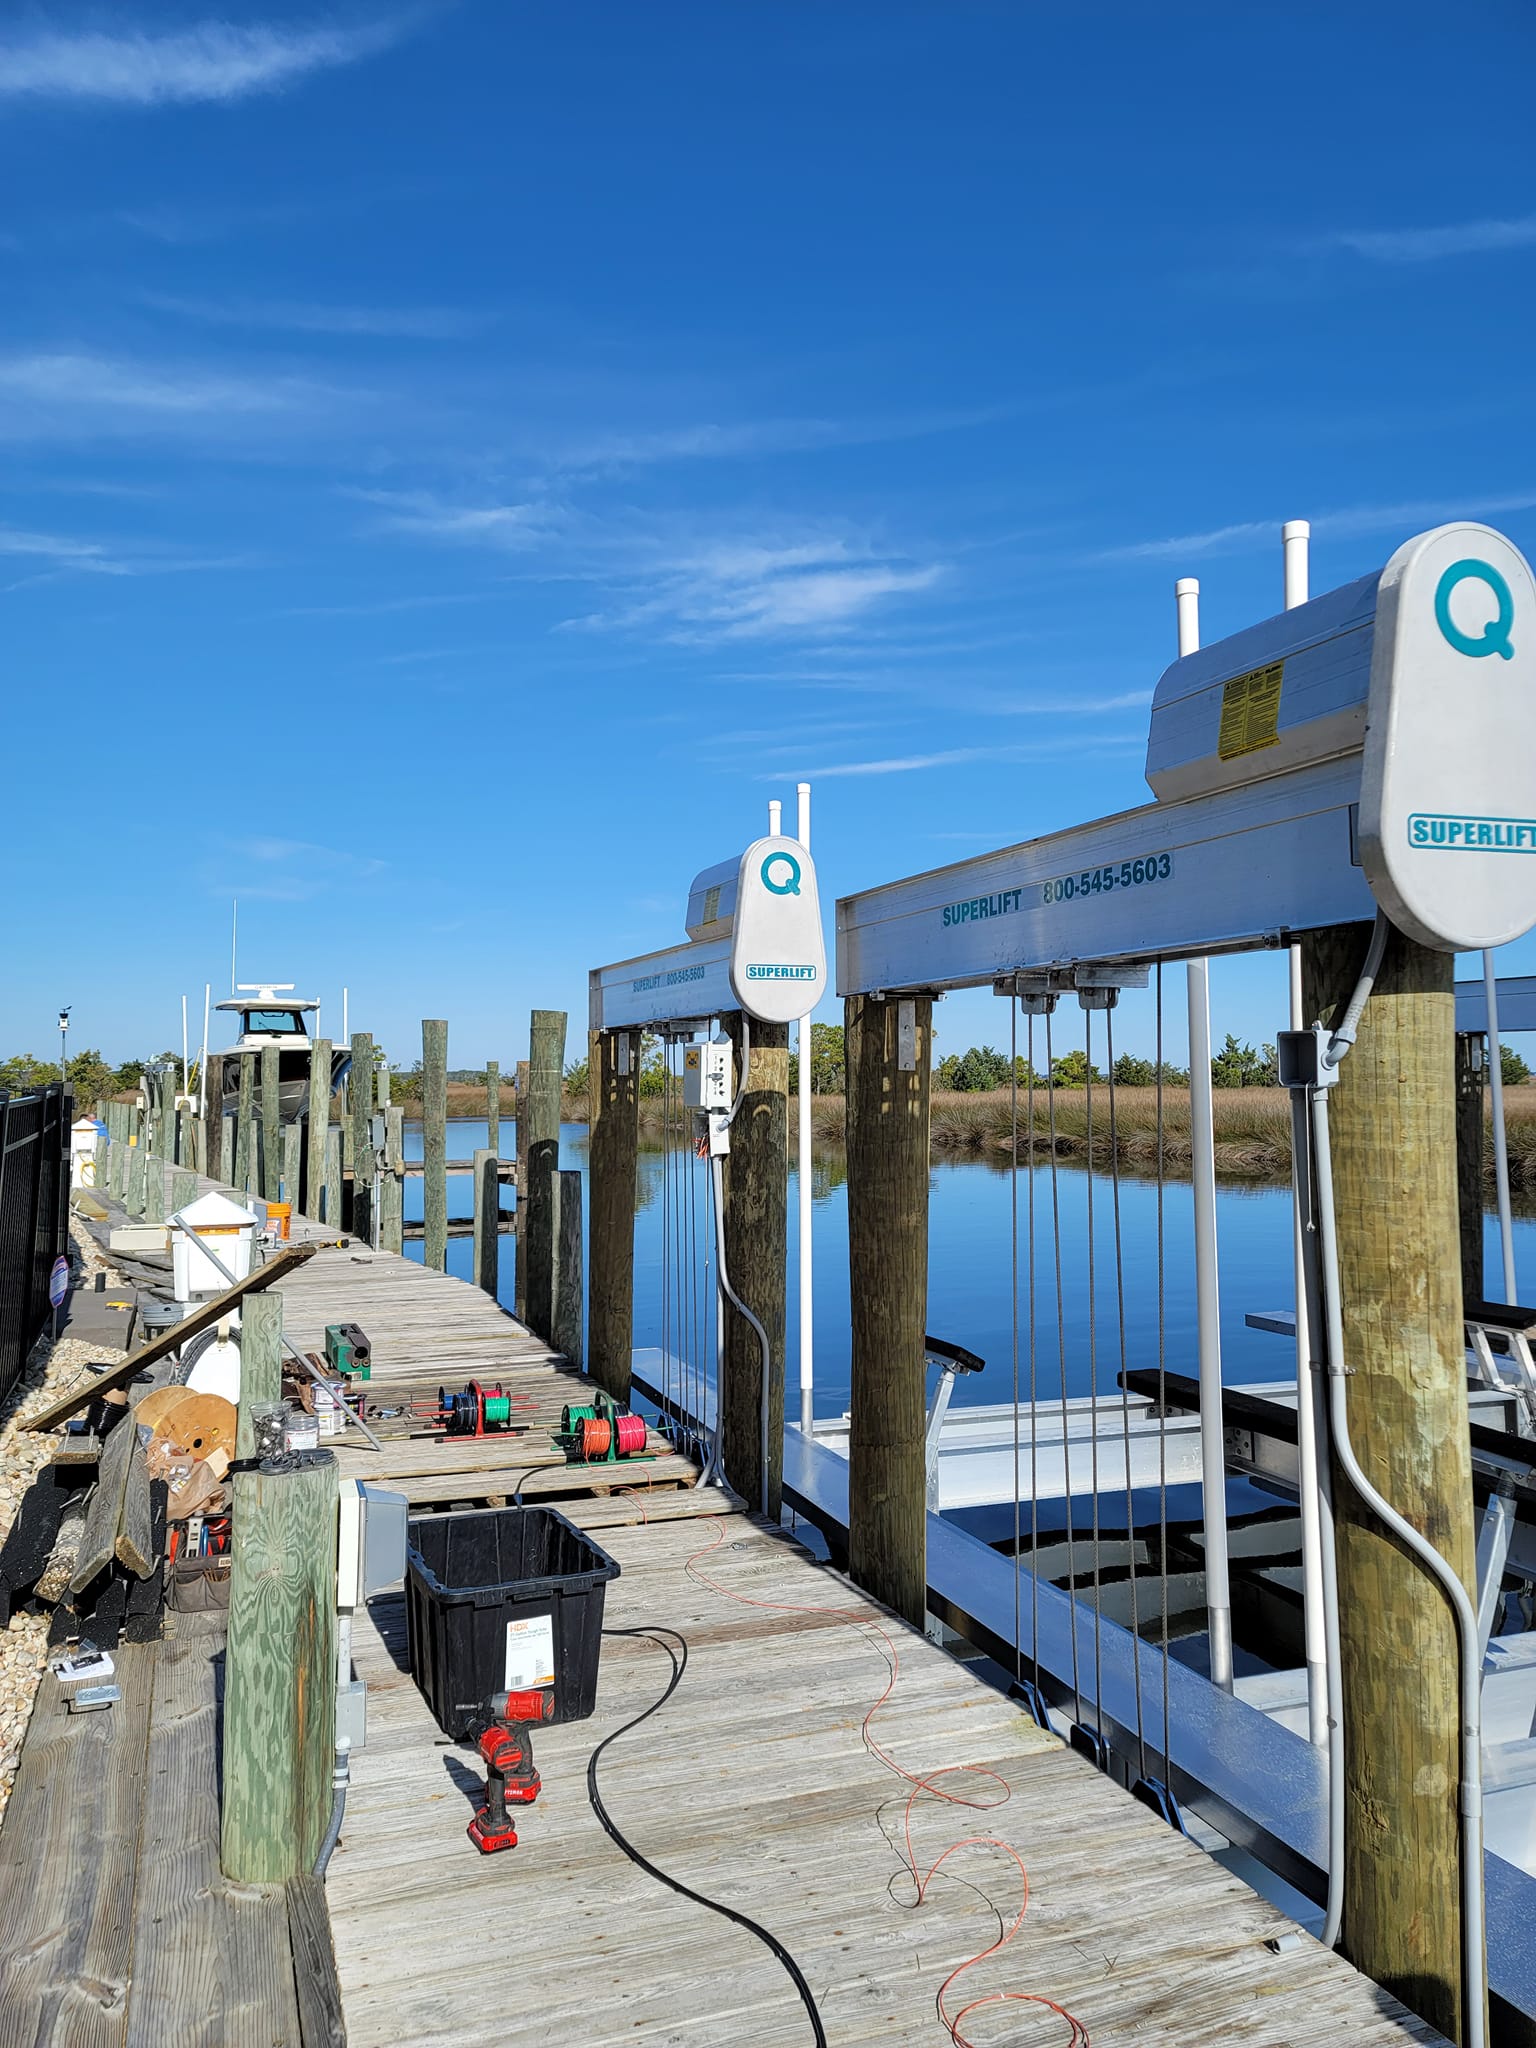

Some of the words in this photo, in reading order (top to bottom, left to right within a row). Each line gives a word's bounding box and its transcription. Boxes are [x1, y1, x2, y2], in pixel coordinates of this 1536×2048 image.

[1435, 558, 1514, 660] Q
[761, 851, 801, 895] Q
[943, 889, 1022, 927] SUPERLIFT
[1043, 853, 1171, 904] 800-545-5603
[633, 975, 660, 993] SUPERLIFT
[748, 966, 814, 978] SUPERLIFT
[509, 1621, 529, 1633] HDX
